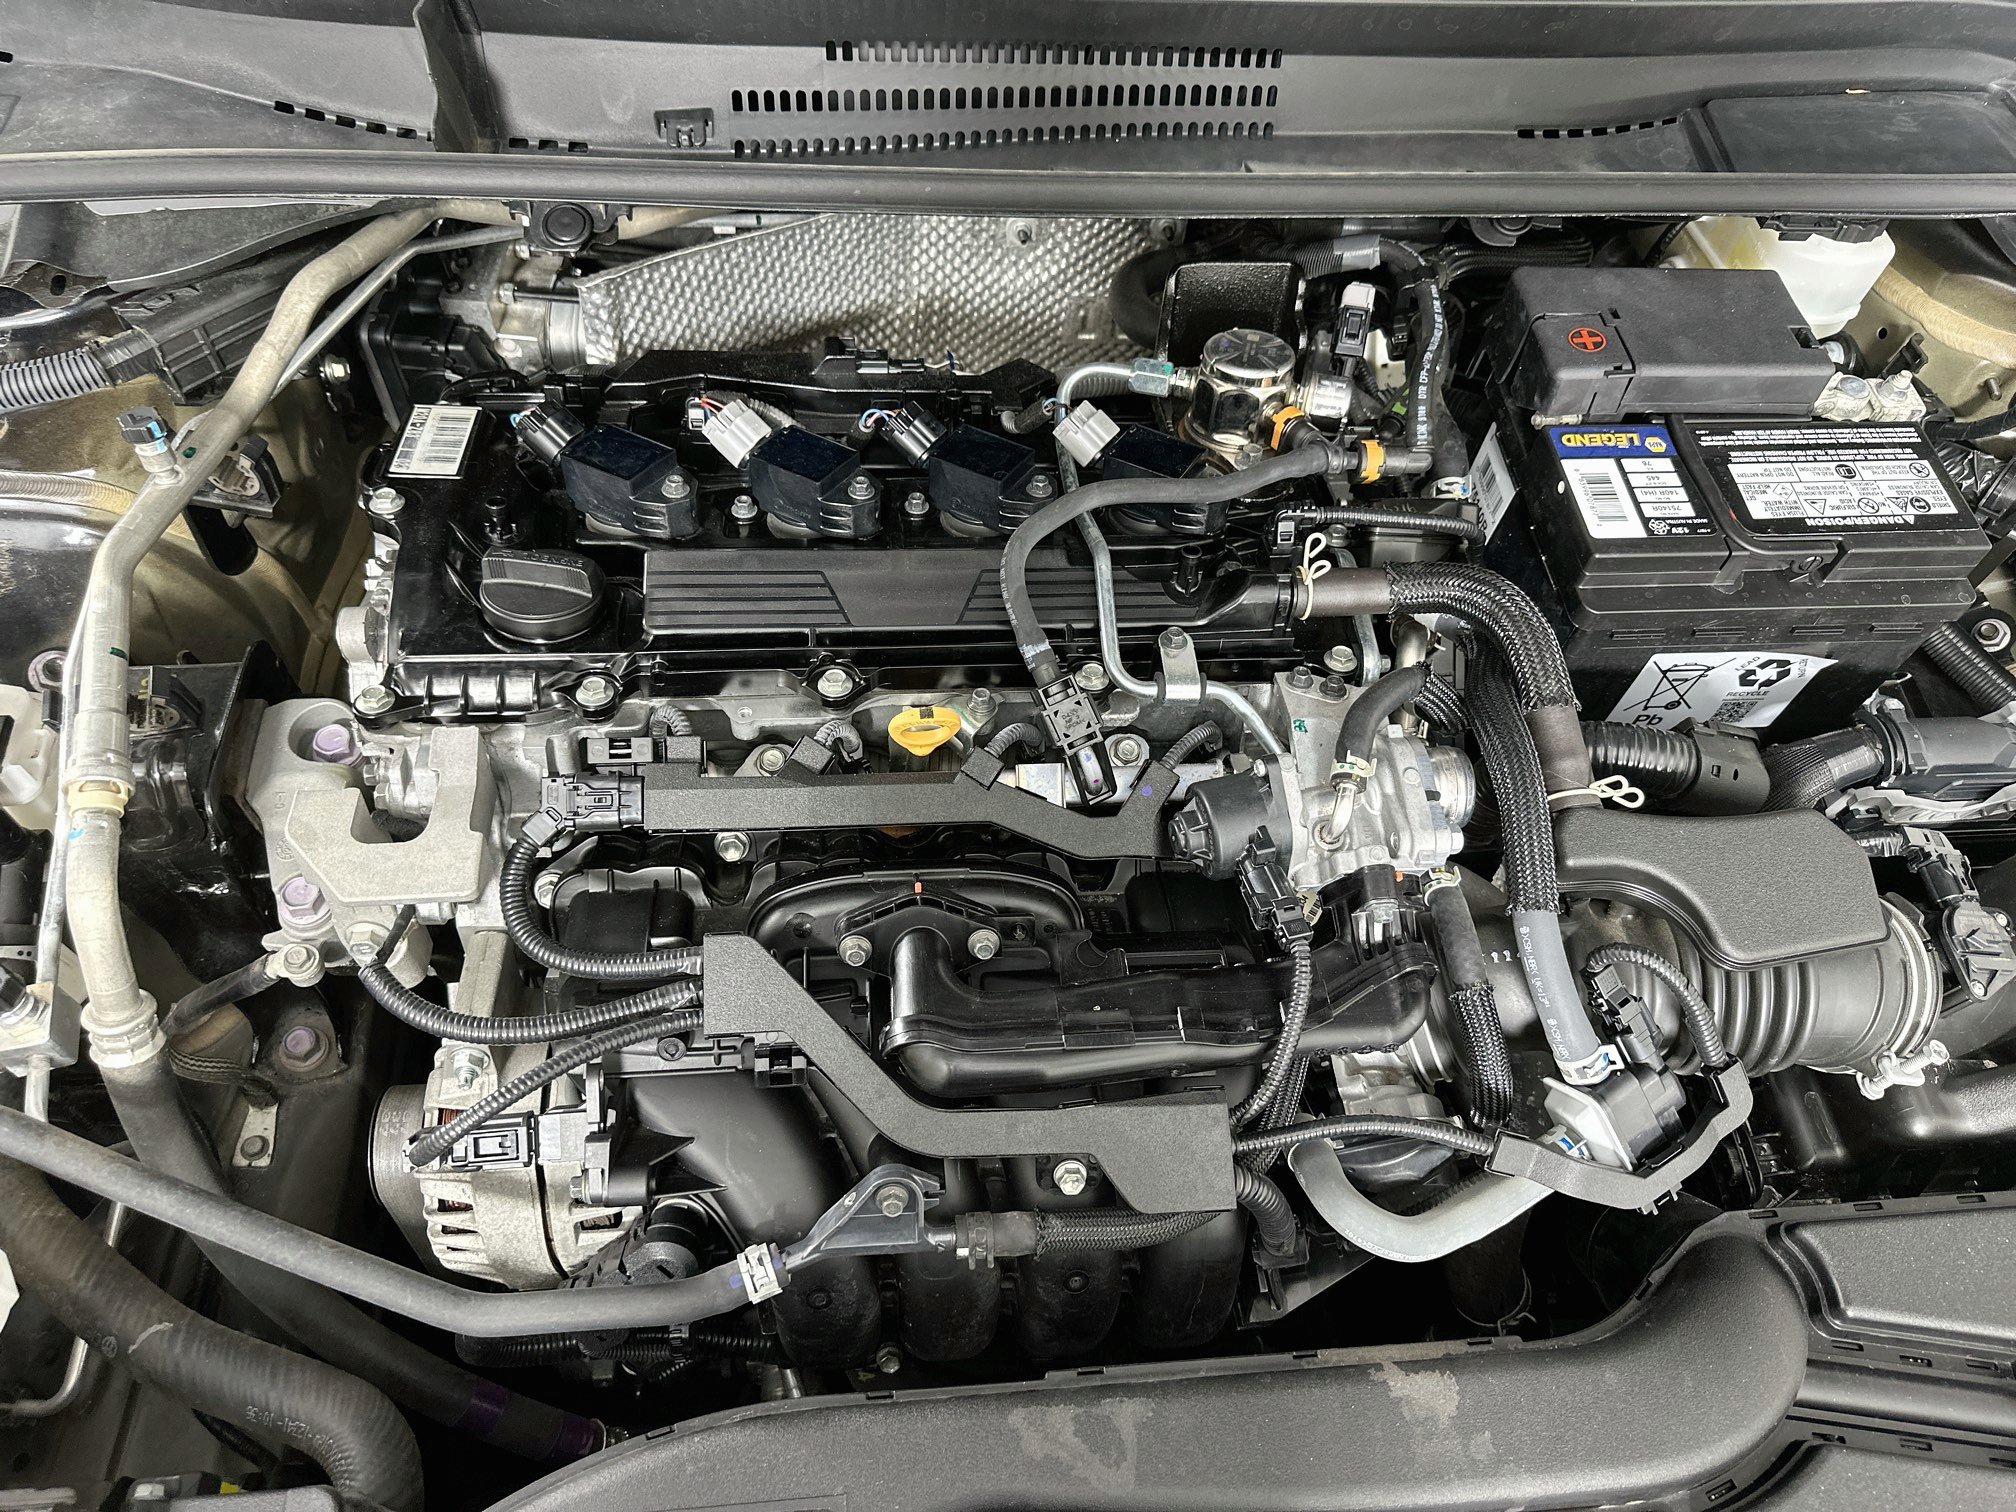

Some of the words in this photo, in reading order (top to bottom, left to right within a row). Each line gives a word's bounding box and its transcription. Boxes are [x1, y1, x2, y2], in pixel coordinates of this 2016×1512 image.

[1561, 433, 1639, 446] LEGEND
[1805, 515, 1904, 525] DANGER/POISON
[1671, 526, 1689, 534] 12V
[542, 556, 584, 567] ENGINE
[1735, 656, 1761, 671] LEAD
[1797, 658, 1809, 679] RETURN
[1632, 714, 1663, 726] Pb
